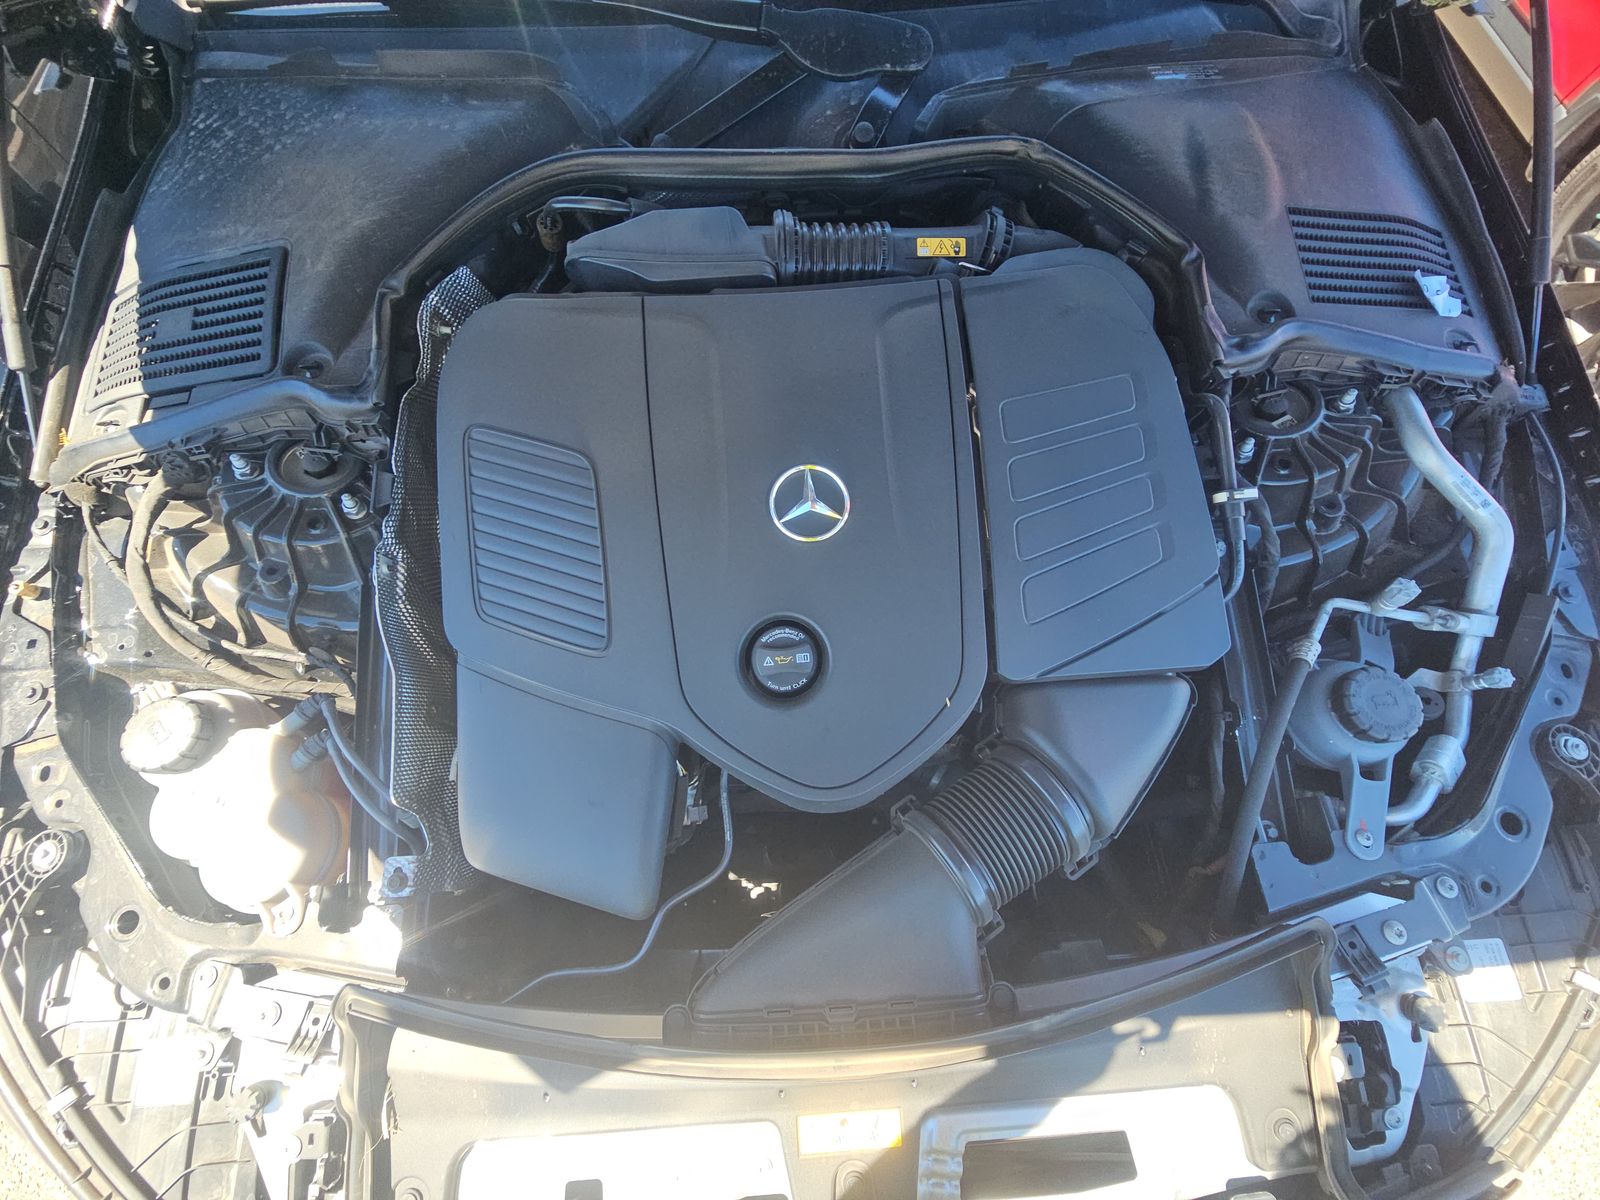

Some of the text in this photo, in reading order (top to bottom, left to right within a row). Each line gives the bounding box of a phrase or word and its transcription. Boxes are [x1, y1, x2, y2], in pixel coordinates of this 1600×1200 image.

[767, 633, 800, 642] recommended
[767, 681, 779, 690] Turn
[793, 677, 808, 688] CLICK
